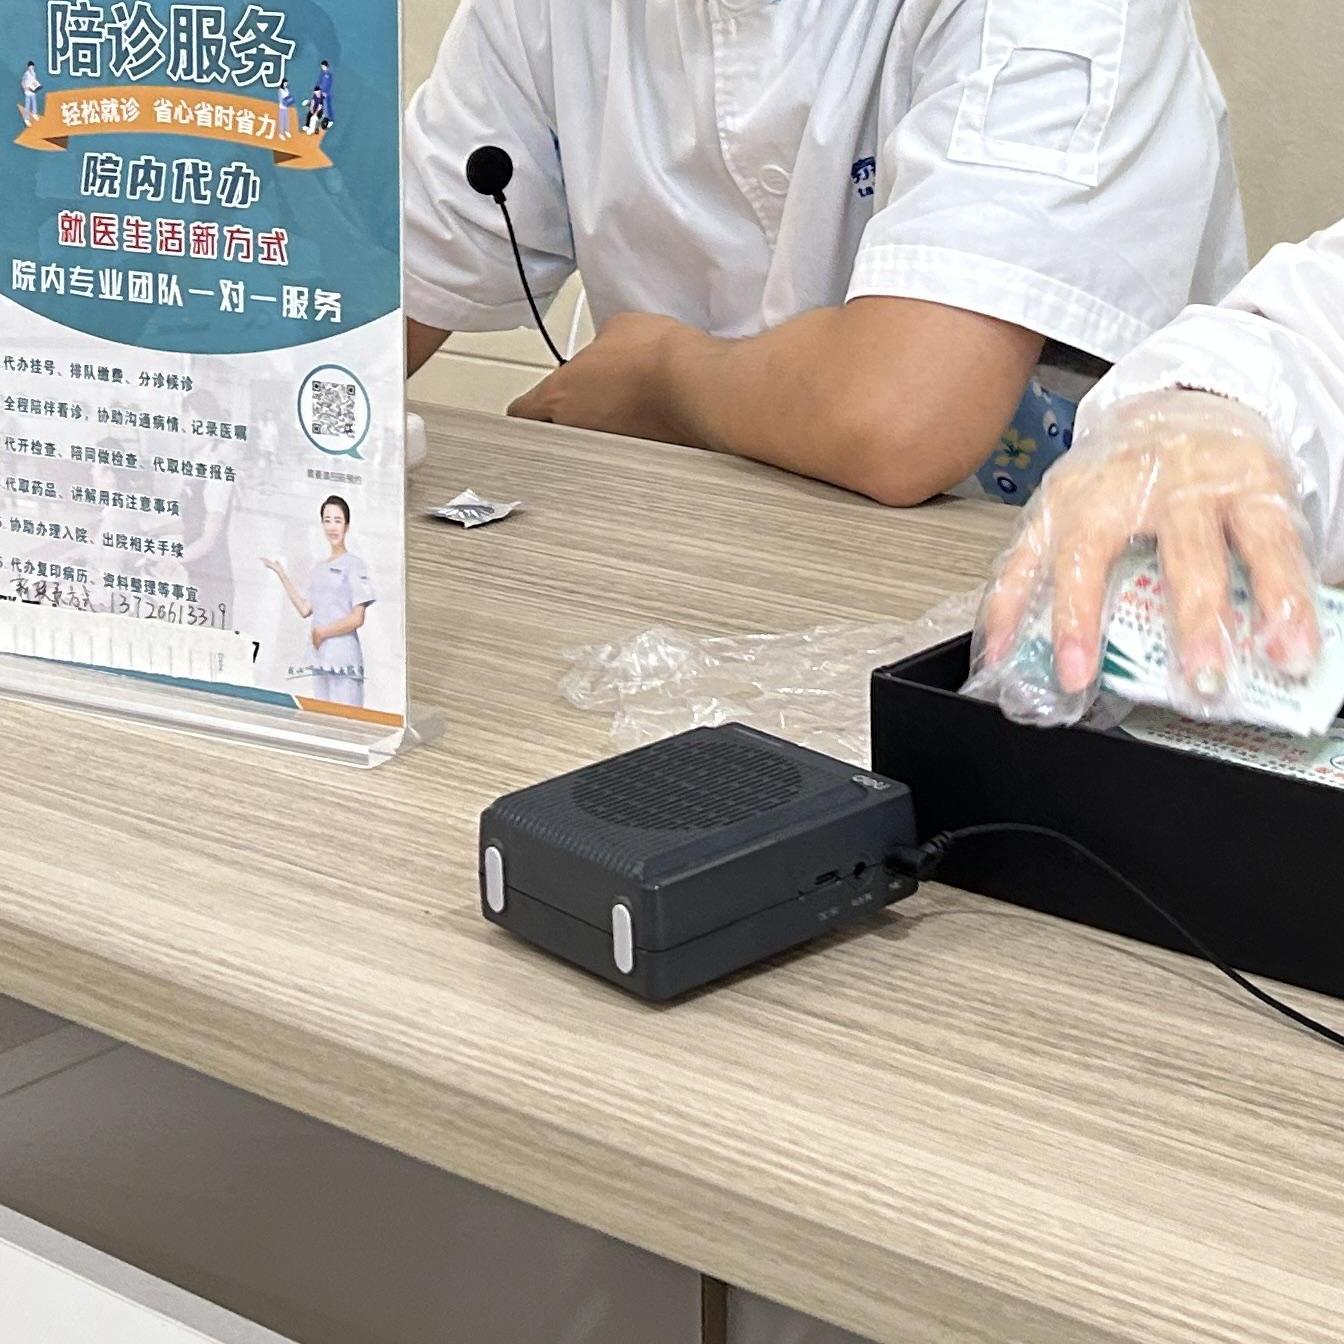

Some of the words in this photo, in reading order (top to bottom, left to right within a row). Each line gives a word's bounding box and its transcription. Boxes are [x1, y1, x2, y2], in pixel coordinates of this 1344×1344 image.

[61, 98, 141, 127] 轻松就诊
[153, 99, 276, 139] 省心省时省力
[81, 153, 261, 208] 院内代办
[58, 210, 289, 265] 就医生活新方式
[11, 259, 343, 323] 院内专业团队一对一服务
